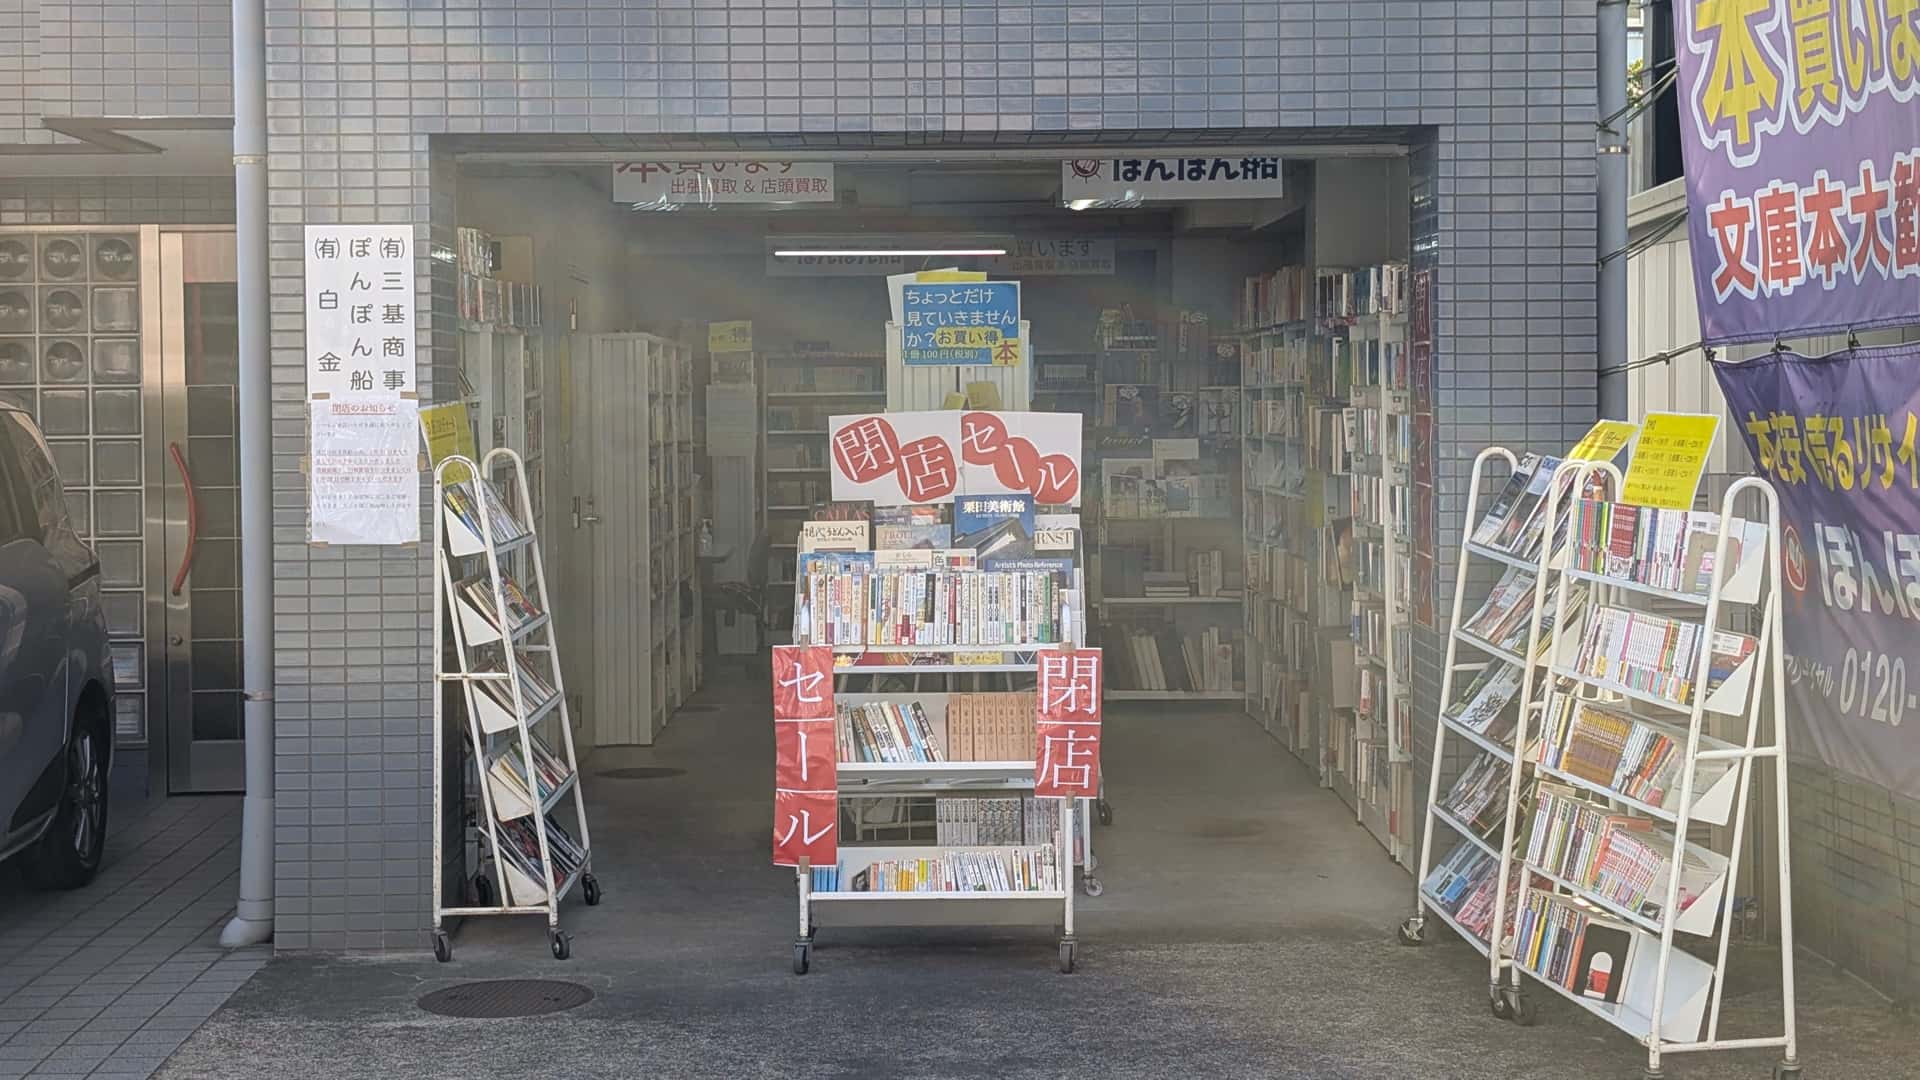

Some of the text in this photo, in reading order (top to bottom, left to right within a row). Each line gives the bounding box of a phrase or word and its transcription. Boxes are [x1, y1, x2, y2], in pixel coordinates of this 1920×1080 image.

[761, 178, 828, 194] 店頭買取
[905, 288, 994, 304] ちょっとだけ
[349, 238, 374, 390] ぽんぽん船
[906, 310, 1017, 326] 見ていきません
[937, 330, 999, 345] お買い得
[994, 339, 1018, 364] 本
[1035, 531, 1073, 545] RNST
[1036, 655, 1099, 790] 閉店
[778, 662, 834, 849] セール
